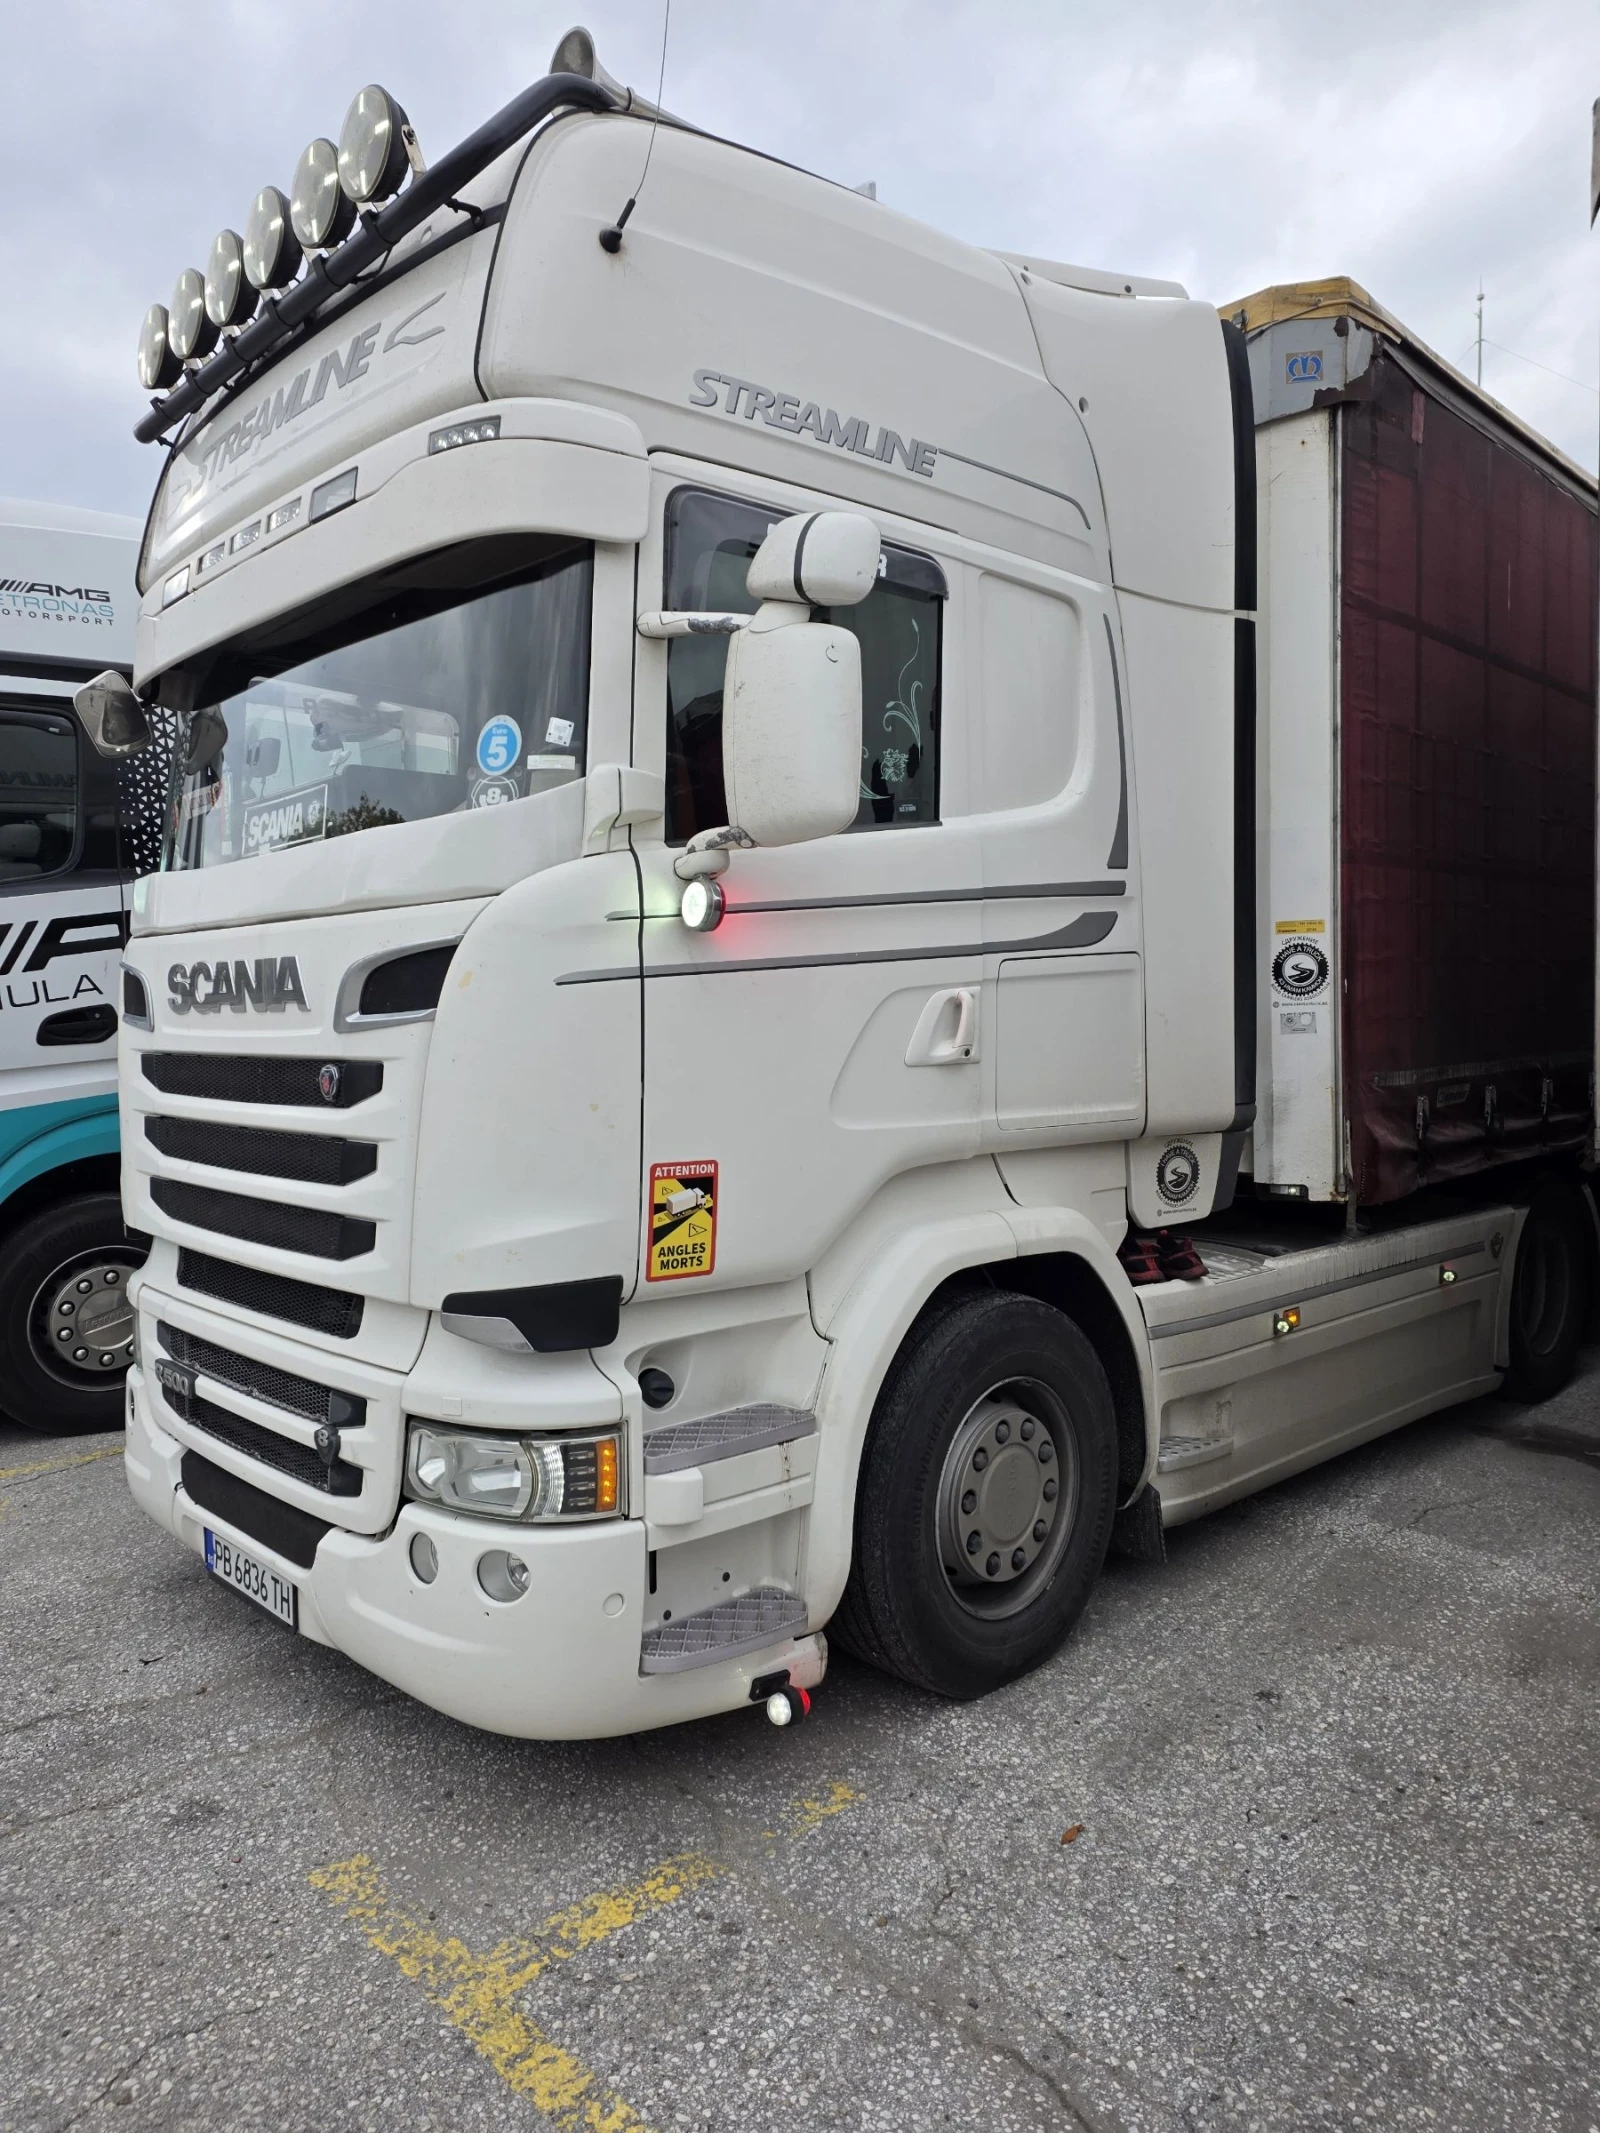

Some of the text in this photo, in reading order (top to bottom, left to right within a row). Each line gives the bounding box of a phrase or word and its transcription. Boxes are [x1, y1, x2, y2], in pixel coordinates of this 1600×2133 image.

[192, 322, 381, 496] STREAMLINE
[688, 368, 938, 478] STREAMLINE
[0, 608, 114, 626] OTORSPORT
[492, 727, 508, 735] Euro
[486, 735, 508, 768] 5
[248, 802, 304, 837] SCANIA
[1281, 946, 1296, 960] HAVE
[1303, 946, 1323, 962] TRUCK
[0, 973, 104, 1010] ULA
[167, 955, 312, 1016] SCANIA
[655, 1163, 715, 1178] ATTENTION
[658, 1242, 706, 1258] ANGLES
[660, 1256, 703, 1271] MORTS
[155, 1363, 189, 1397] R500
[215, 1538, 290, 1619] PB 6836 TH
